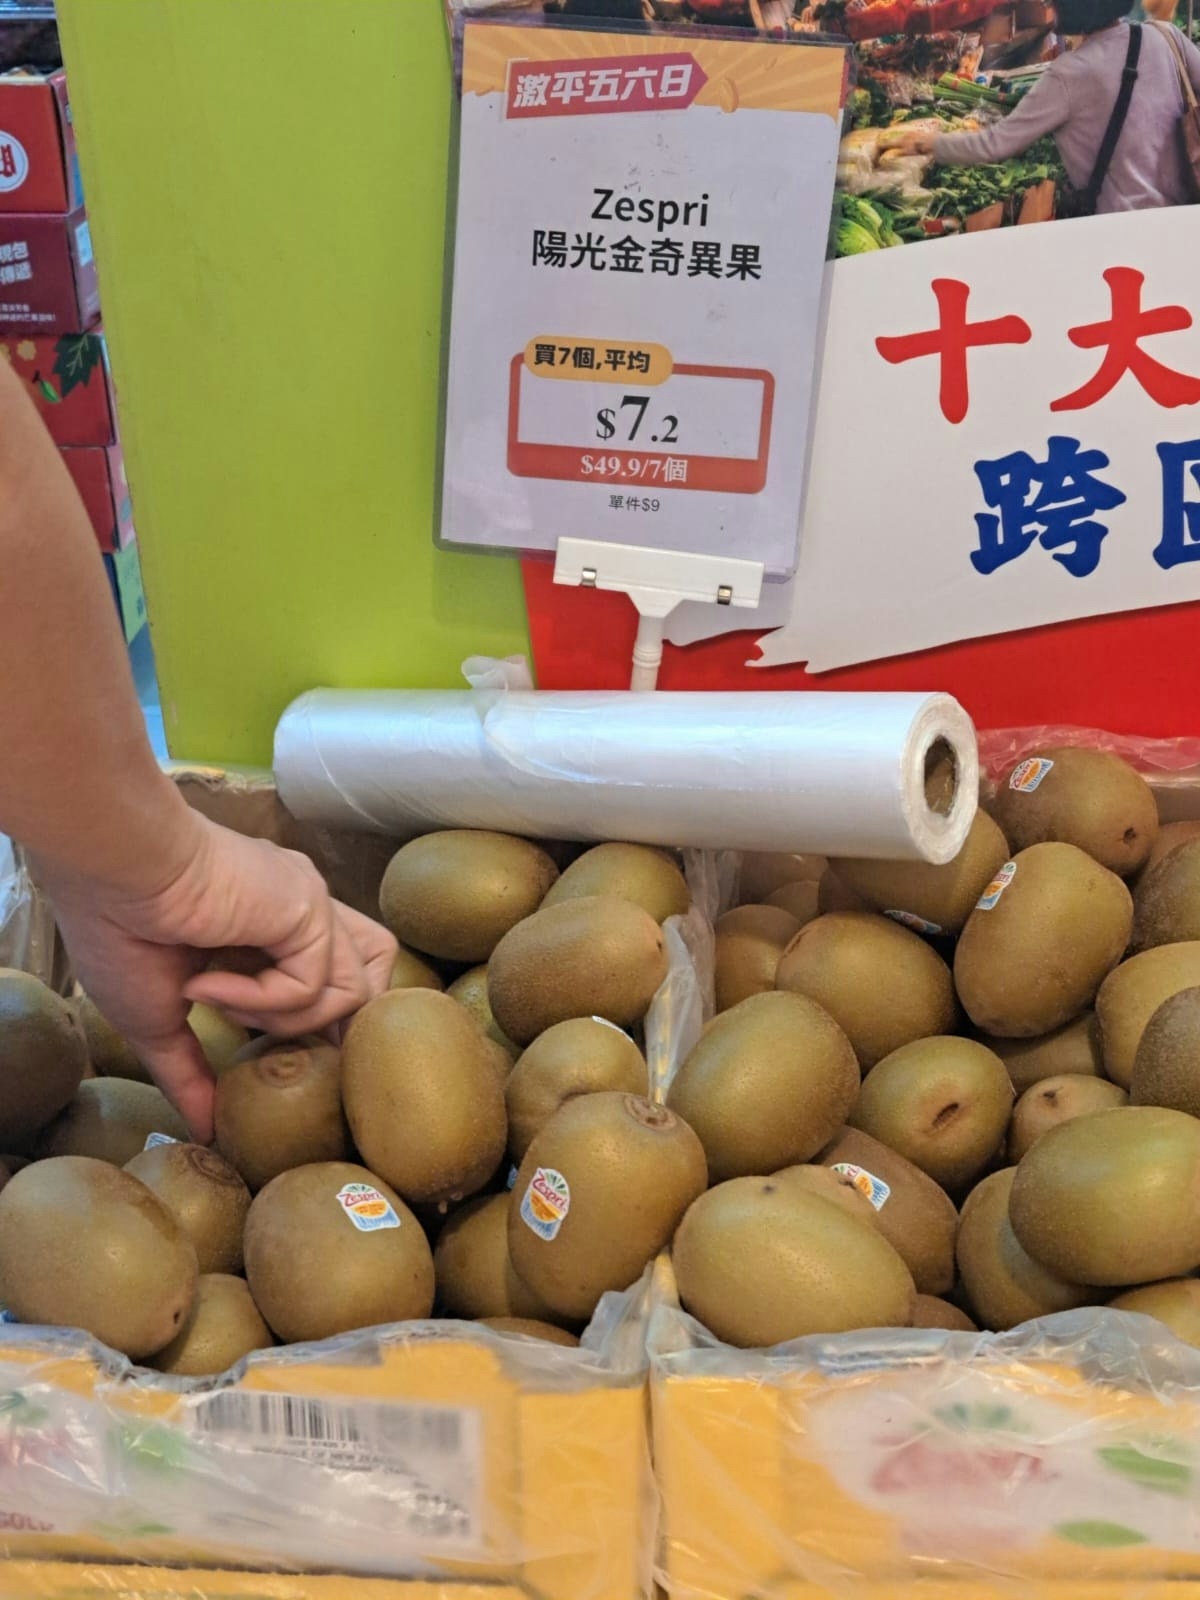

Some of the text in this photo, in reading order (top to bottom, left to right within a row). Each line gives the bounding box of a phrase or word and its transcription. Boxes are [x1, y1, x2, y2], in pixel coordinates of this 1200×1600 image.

[513, 63, 693, 107] 激平五六日
[590, 188, 709, 232] Zespri
[532, 229, 762, 281] 陽光金奇異果
[533, 343, 651, 374] 買7個,平均
[596, 395, 679, 443] $7.2
[580, 454, 688, 483] $49.9/7個
[608, 494, 661, 513] 單件$9
